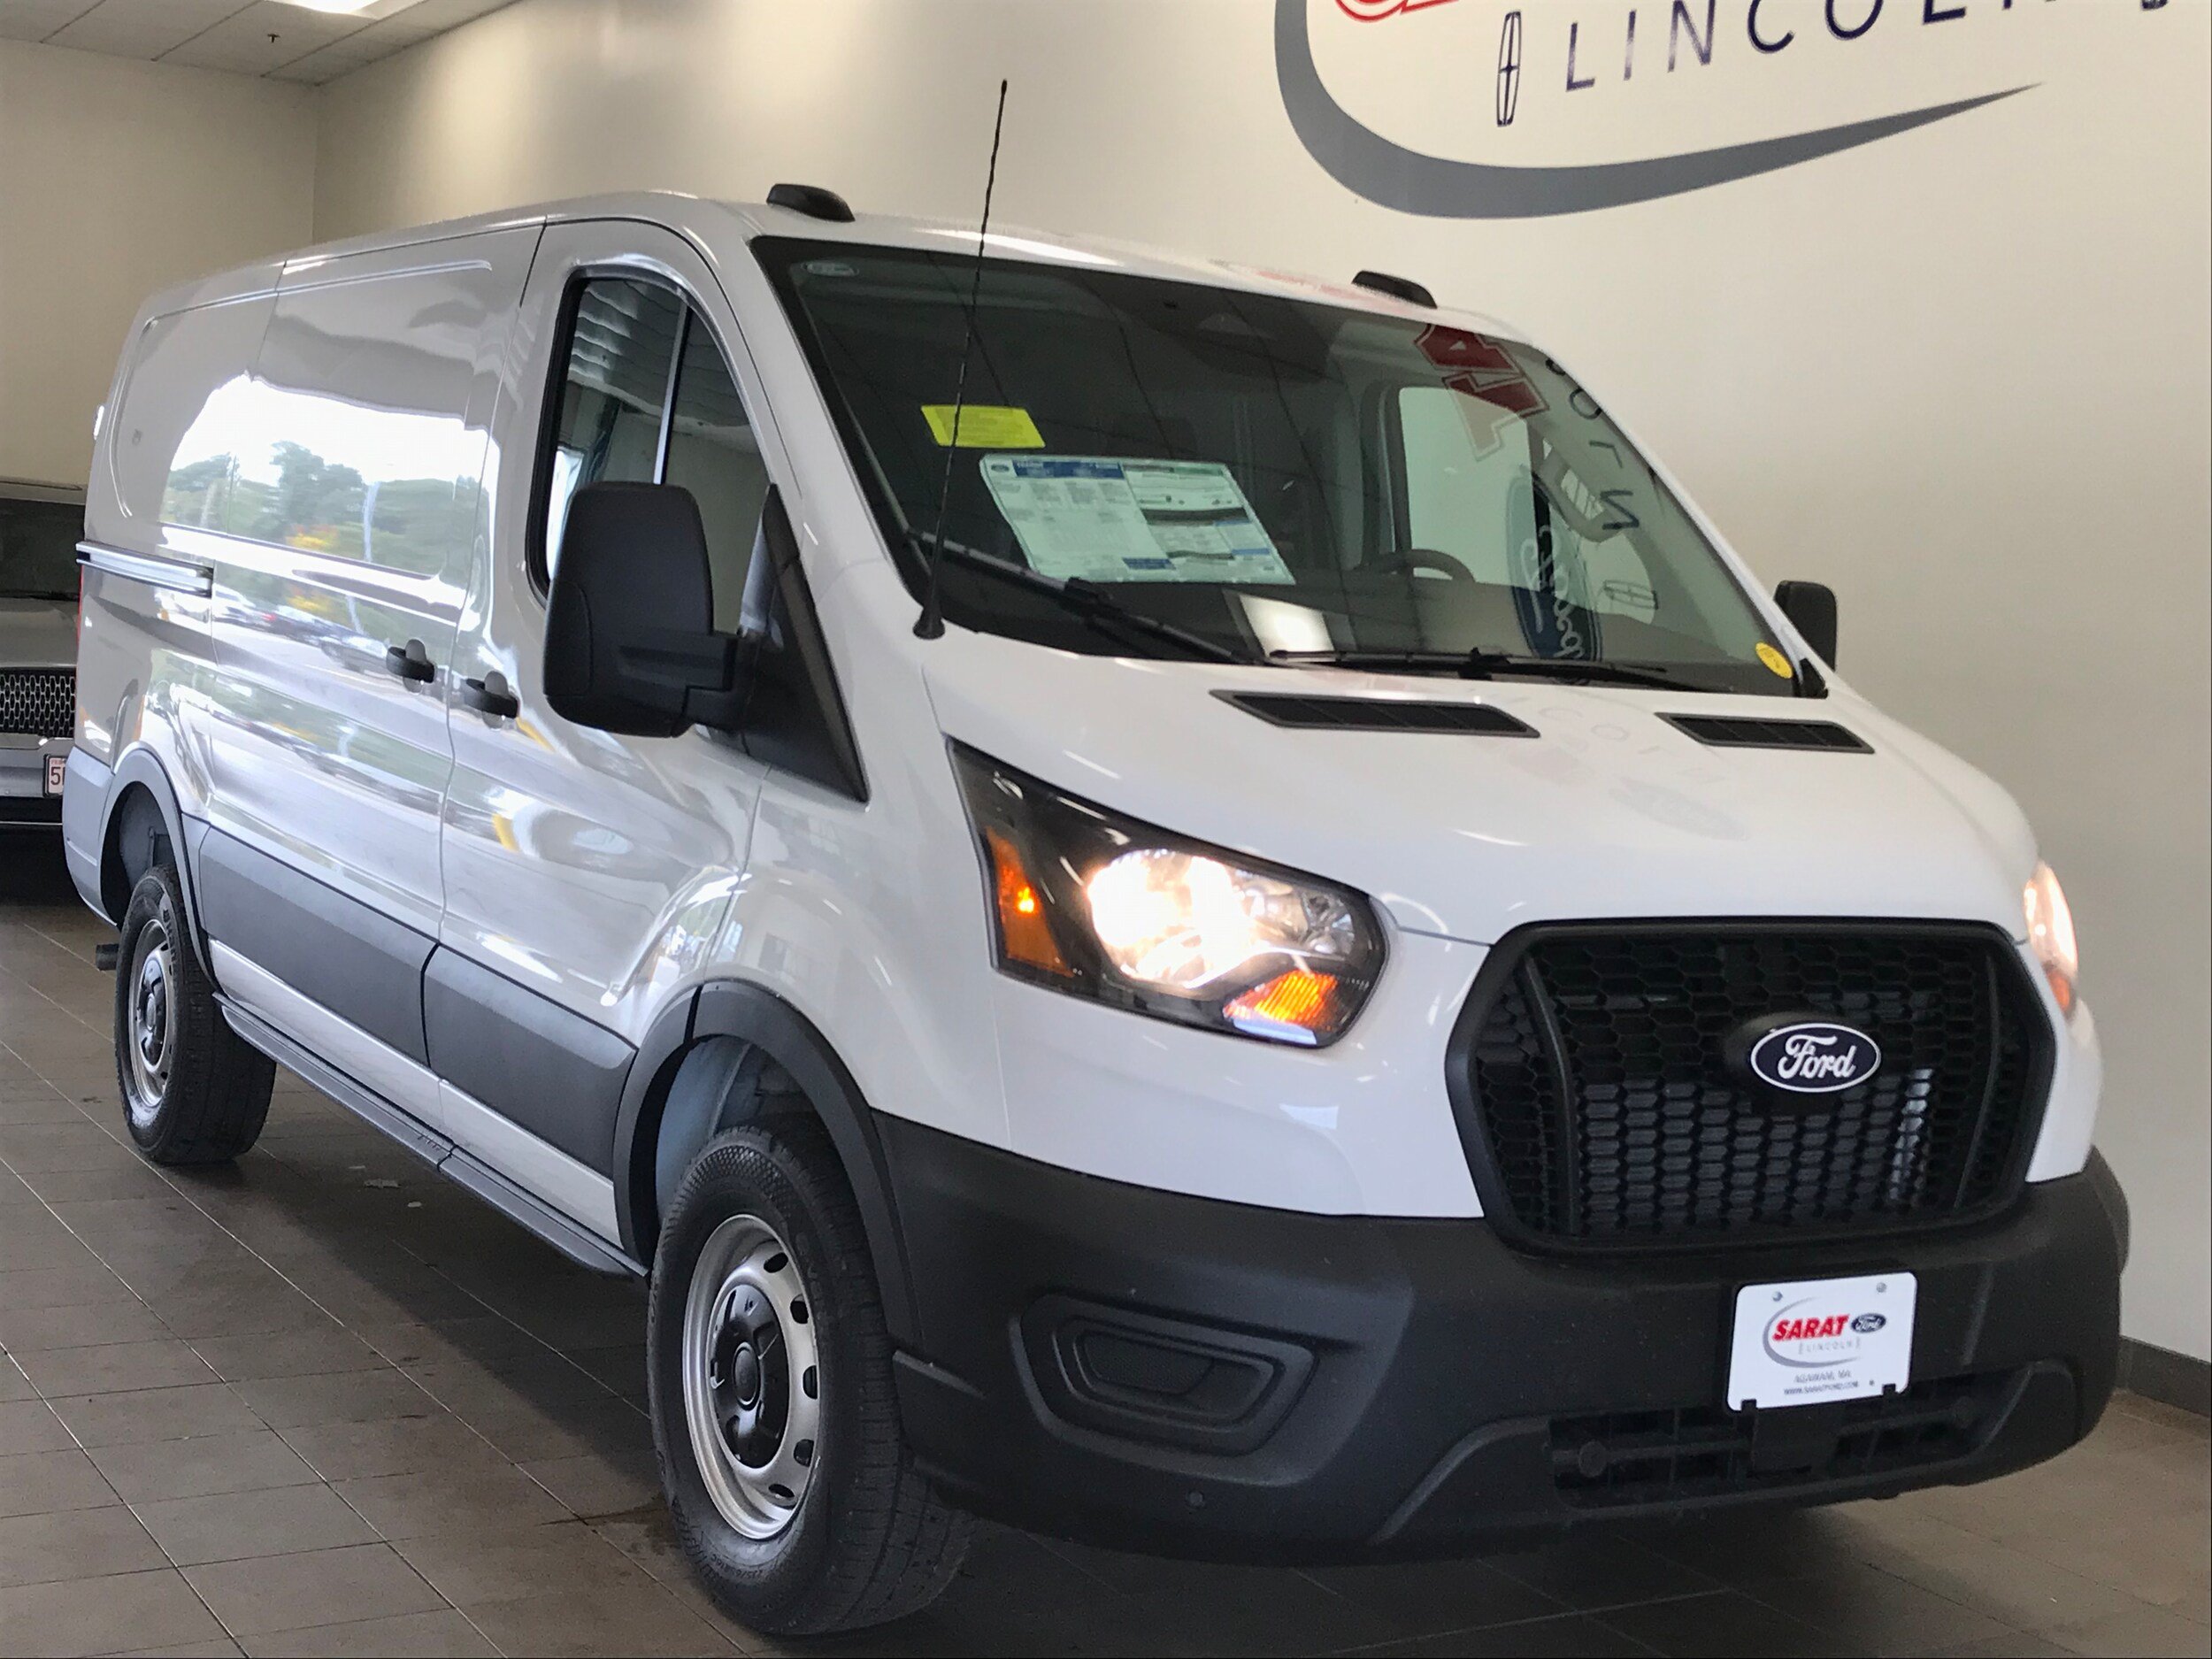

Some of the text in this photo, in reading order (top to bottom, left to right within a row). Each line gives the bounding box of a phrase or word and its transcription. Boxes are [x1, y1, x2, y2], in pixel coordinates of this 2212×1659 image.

[1777, 1033, 1857, 1080] Ford
[1773, 1315, 1886, 1341] SARAT Ford
